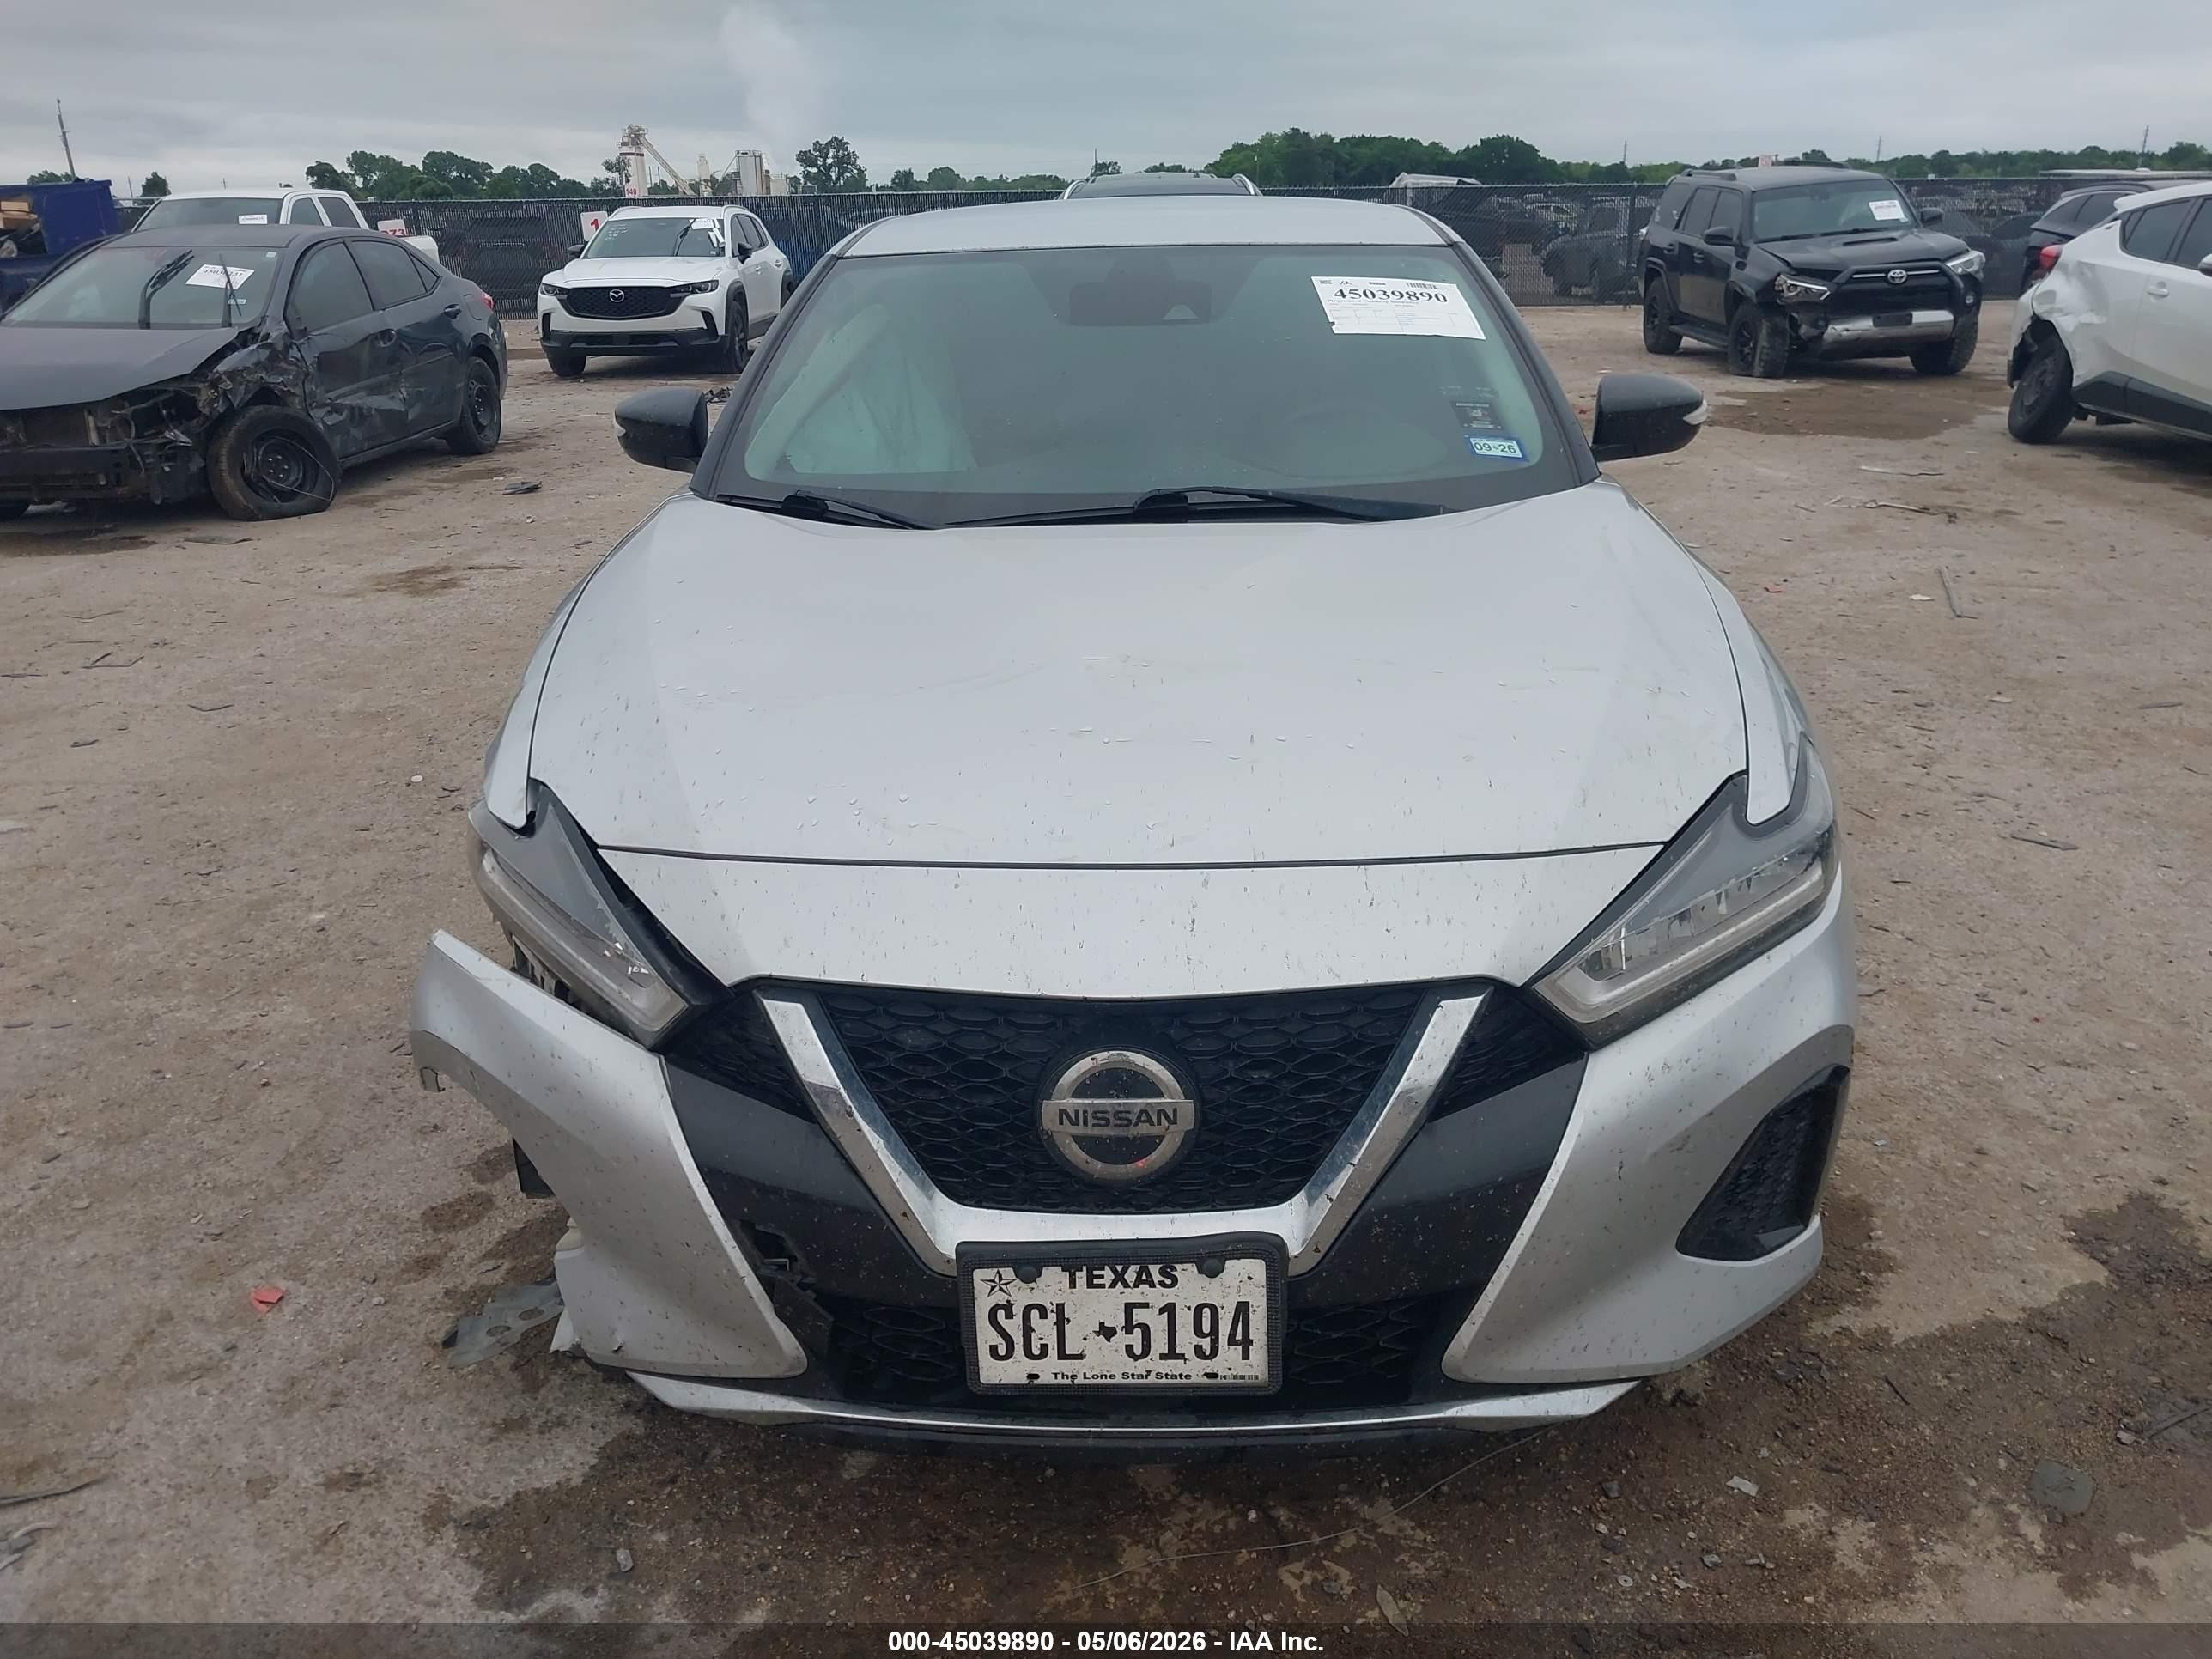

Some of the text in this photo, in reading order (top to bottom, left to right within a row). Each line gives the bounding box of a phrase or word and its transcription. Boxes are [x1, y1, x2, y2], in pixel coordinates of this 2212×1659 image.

[625, 187, 637, 196] 140
[1334, 289, 1448, 304] 45039890
[1474, 442, 1516, 453] 09 26
[1058, 1108, 1177, 1127] NISSAN
[1062, 1264, 1179, 1290] TEXAS
[988, 1300, 1254, 1362] SCL 5194
[1052, 1372, 1193, 1381] The Lone Star State
